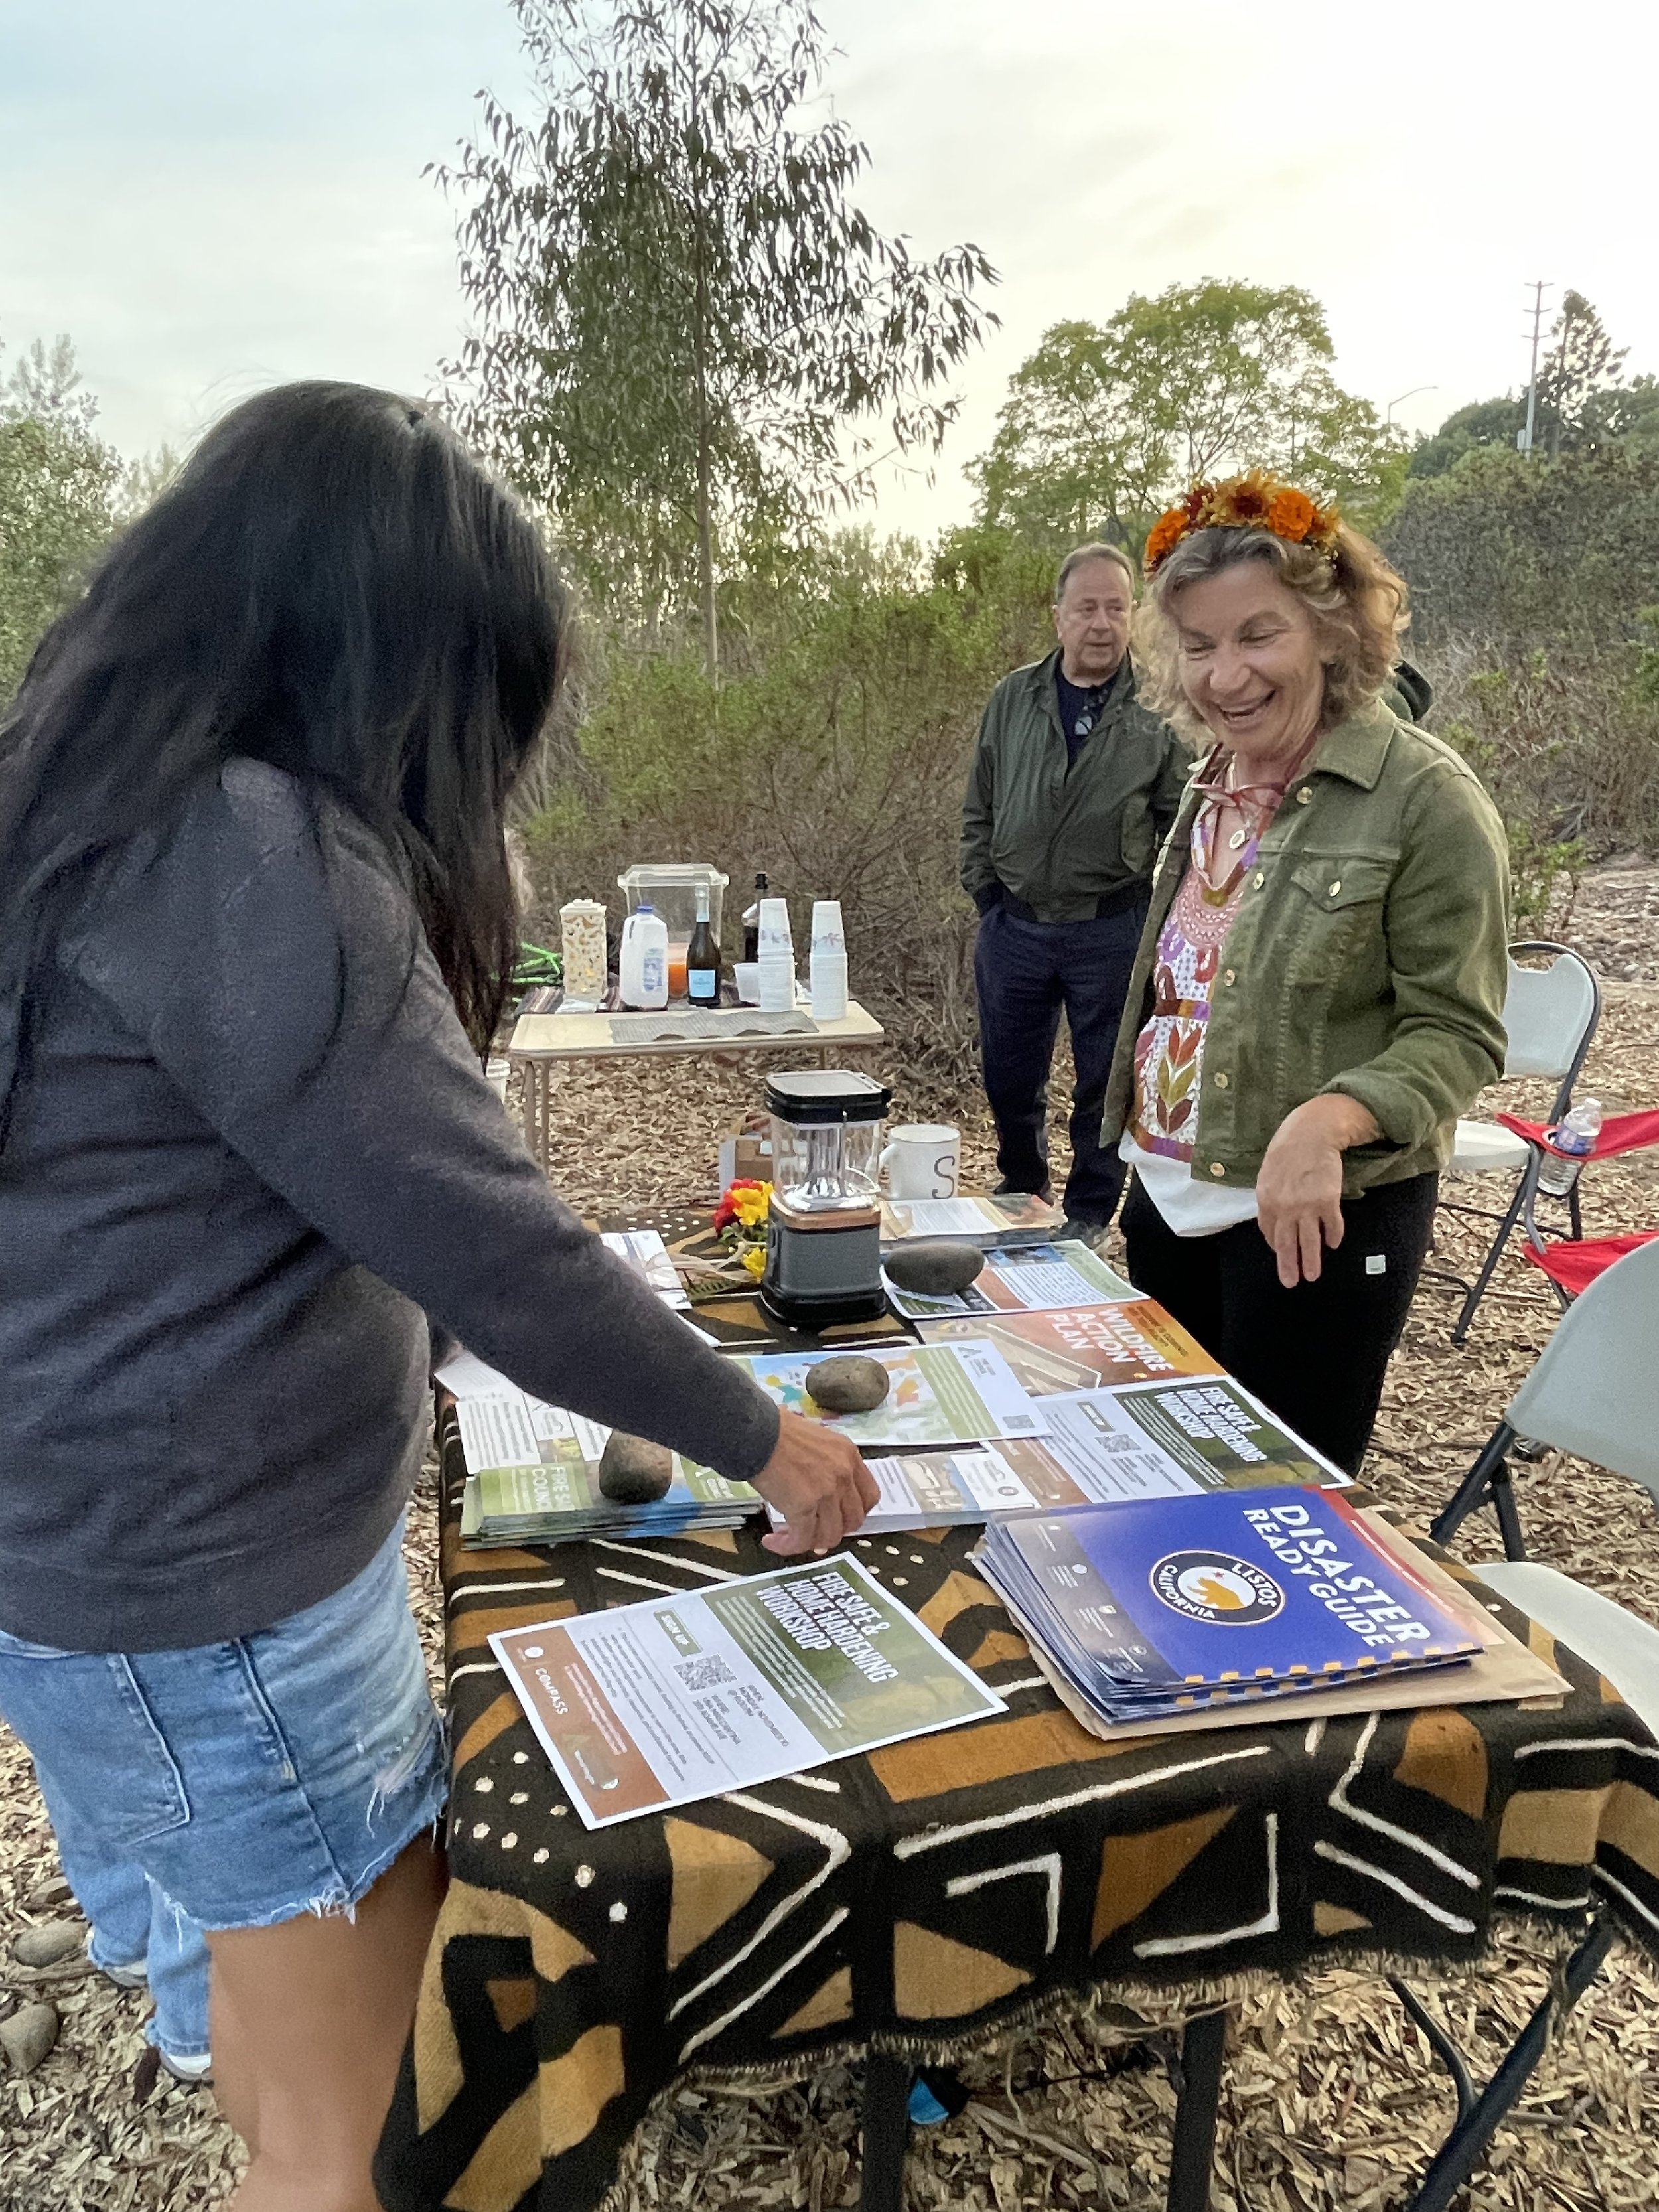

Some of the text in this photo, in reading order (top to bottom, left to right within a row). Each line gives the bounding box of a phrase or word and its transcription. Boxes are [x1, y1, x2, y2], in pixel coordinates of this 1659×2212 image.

[1043, 1313, 1096, 1349] PLAN
[1069, 1313, 1138, 1363] ACTION
[1096, 1306, 1177, 1371] WILDFIRE
[1158, 1564, 1218, 1619] CALIFORNIA
[1230, 1562, 1275, 1607] LISTOS
[1241, 1509, 1396, 1647] READY GUIDE
[1266, 1503, 1432, 1642] DISASTER
[660, 1615, 689, 1645] SIGN UP
[752, 1585, 835, 1653] WORKSHOP
[781, 1578, 836, 1615] HOME
[811, 1609, 901, 1684] HARDENING
[810, 1571, 895, 1637] FIRE SAFE &
[532, 1666, 571, 1715] COMPASS
